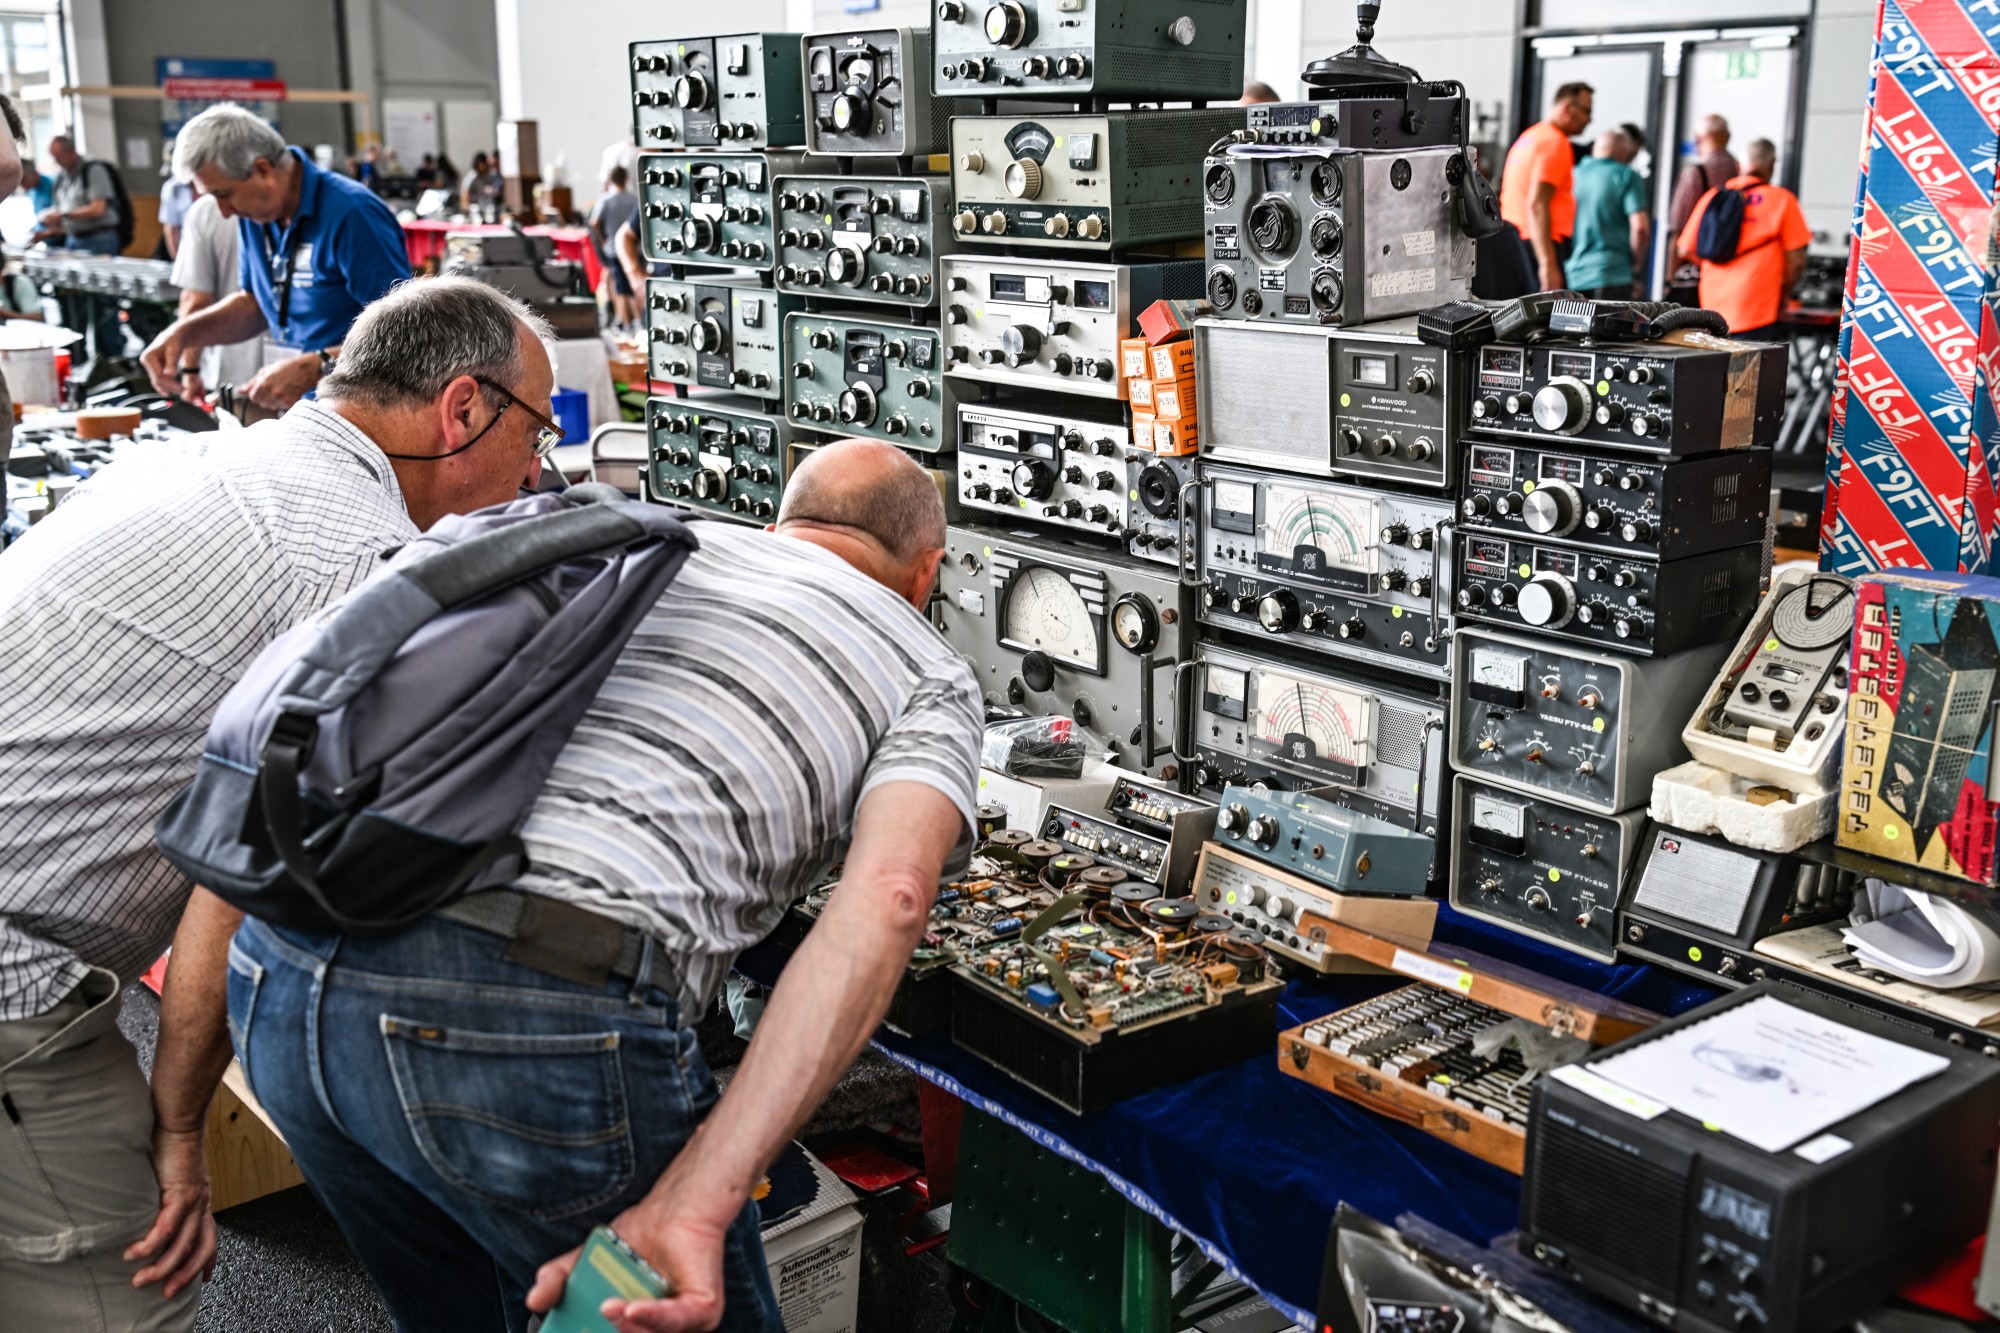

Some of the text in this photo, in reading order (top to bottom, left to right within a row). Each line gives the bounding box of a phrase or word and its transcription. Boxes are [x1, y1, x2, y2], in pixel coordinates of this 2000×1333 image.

[1881, 22, 1955, 98] F9FT
[1875, 109, 1963, 187] F9FT
[1898, 214, 1985, 292] F9FT
[1377, 397, 1407, 406] KENWOOD
[1860, 453, 1946, 528] F9FT
[1547, 664, 1560, 672] PLATE
[1539, 713, 1603, 734] YAESU FTV-650
[1846, 602, 1885, 834] TELETESTER
[1574, 873, 1609, 889] FTV-250
[1005, 1111, 1040, 1138] QUALITY
[780, 1246, 835, 1275] Automatik-
[780, 1247, 850, 1285] Antennenrotor
[1224, 1300, 1273, 1321] PARKS
